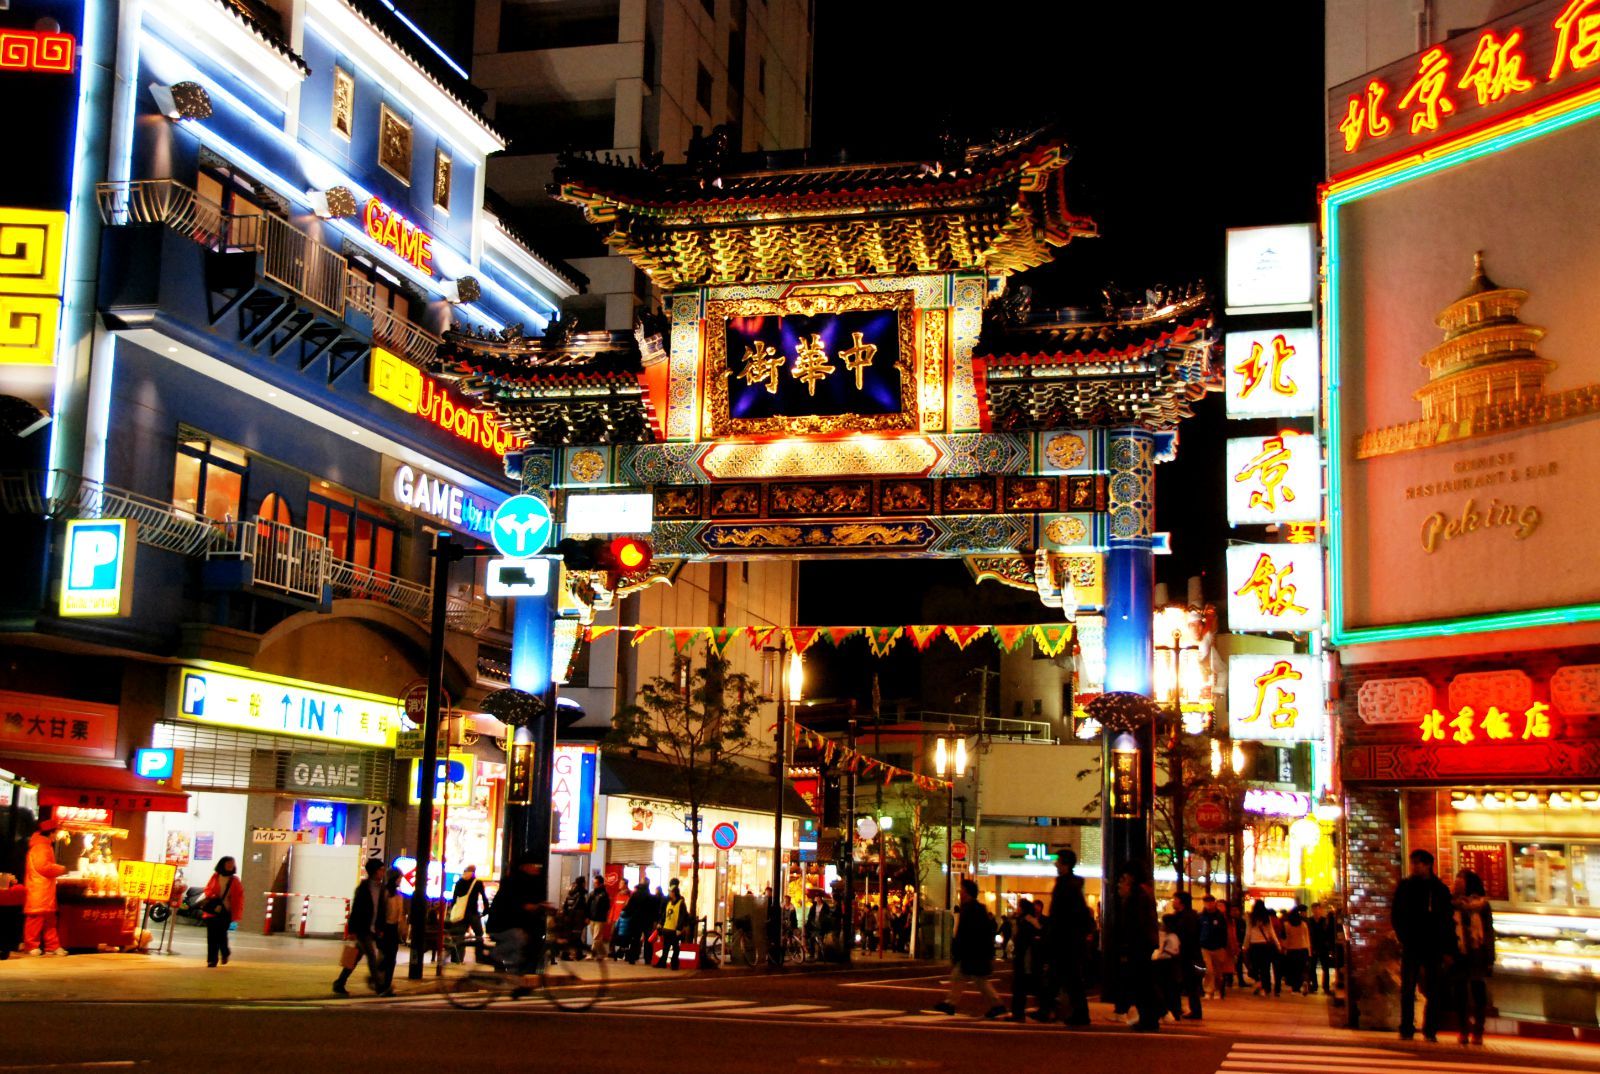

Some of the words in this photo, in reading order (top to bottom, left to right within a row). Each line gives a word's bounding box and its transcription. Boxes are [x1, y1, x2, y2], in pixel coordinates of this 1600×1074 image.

[365, 197, 434, 278] GAME
[1405, 471, 1504, 500] RESTAURANT
[1509, 468, 1519, 483] &
[1525, 462, 1558, 482] BAR
[1453, 451, 1516, 474] CHINESE
[393, 465, 464, 524] GAME
[1233, 333, 1310, 731] 北京飯店
[1421, 498, 1542, 554] Peking
[70, 530, 118, 588] P
[184, 676, 206, 714] P
[299, 696, 325, 731] IN
[1419, 701, 1550, 744] 北京飯店
[140, 751, 168, 777] P
[293, 762, 360, 787] GAME
[255, 832, 287, 842] ハイルーフ
[369, 806, 386, 857] ハイルーフ
